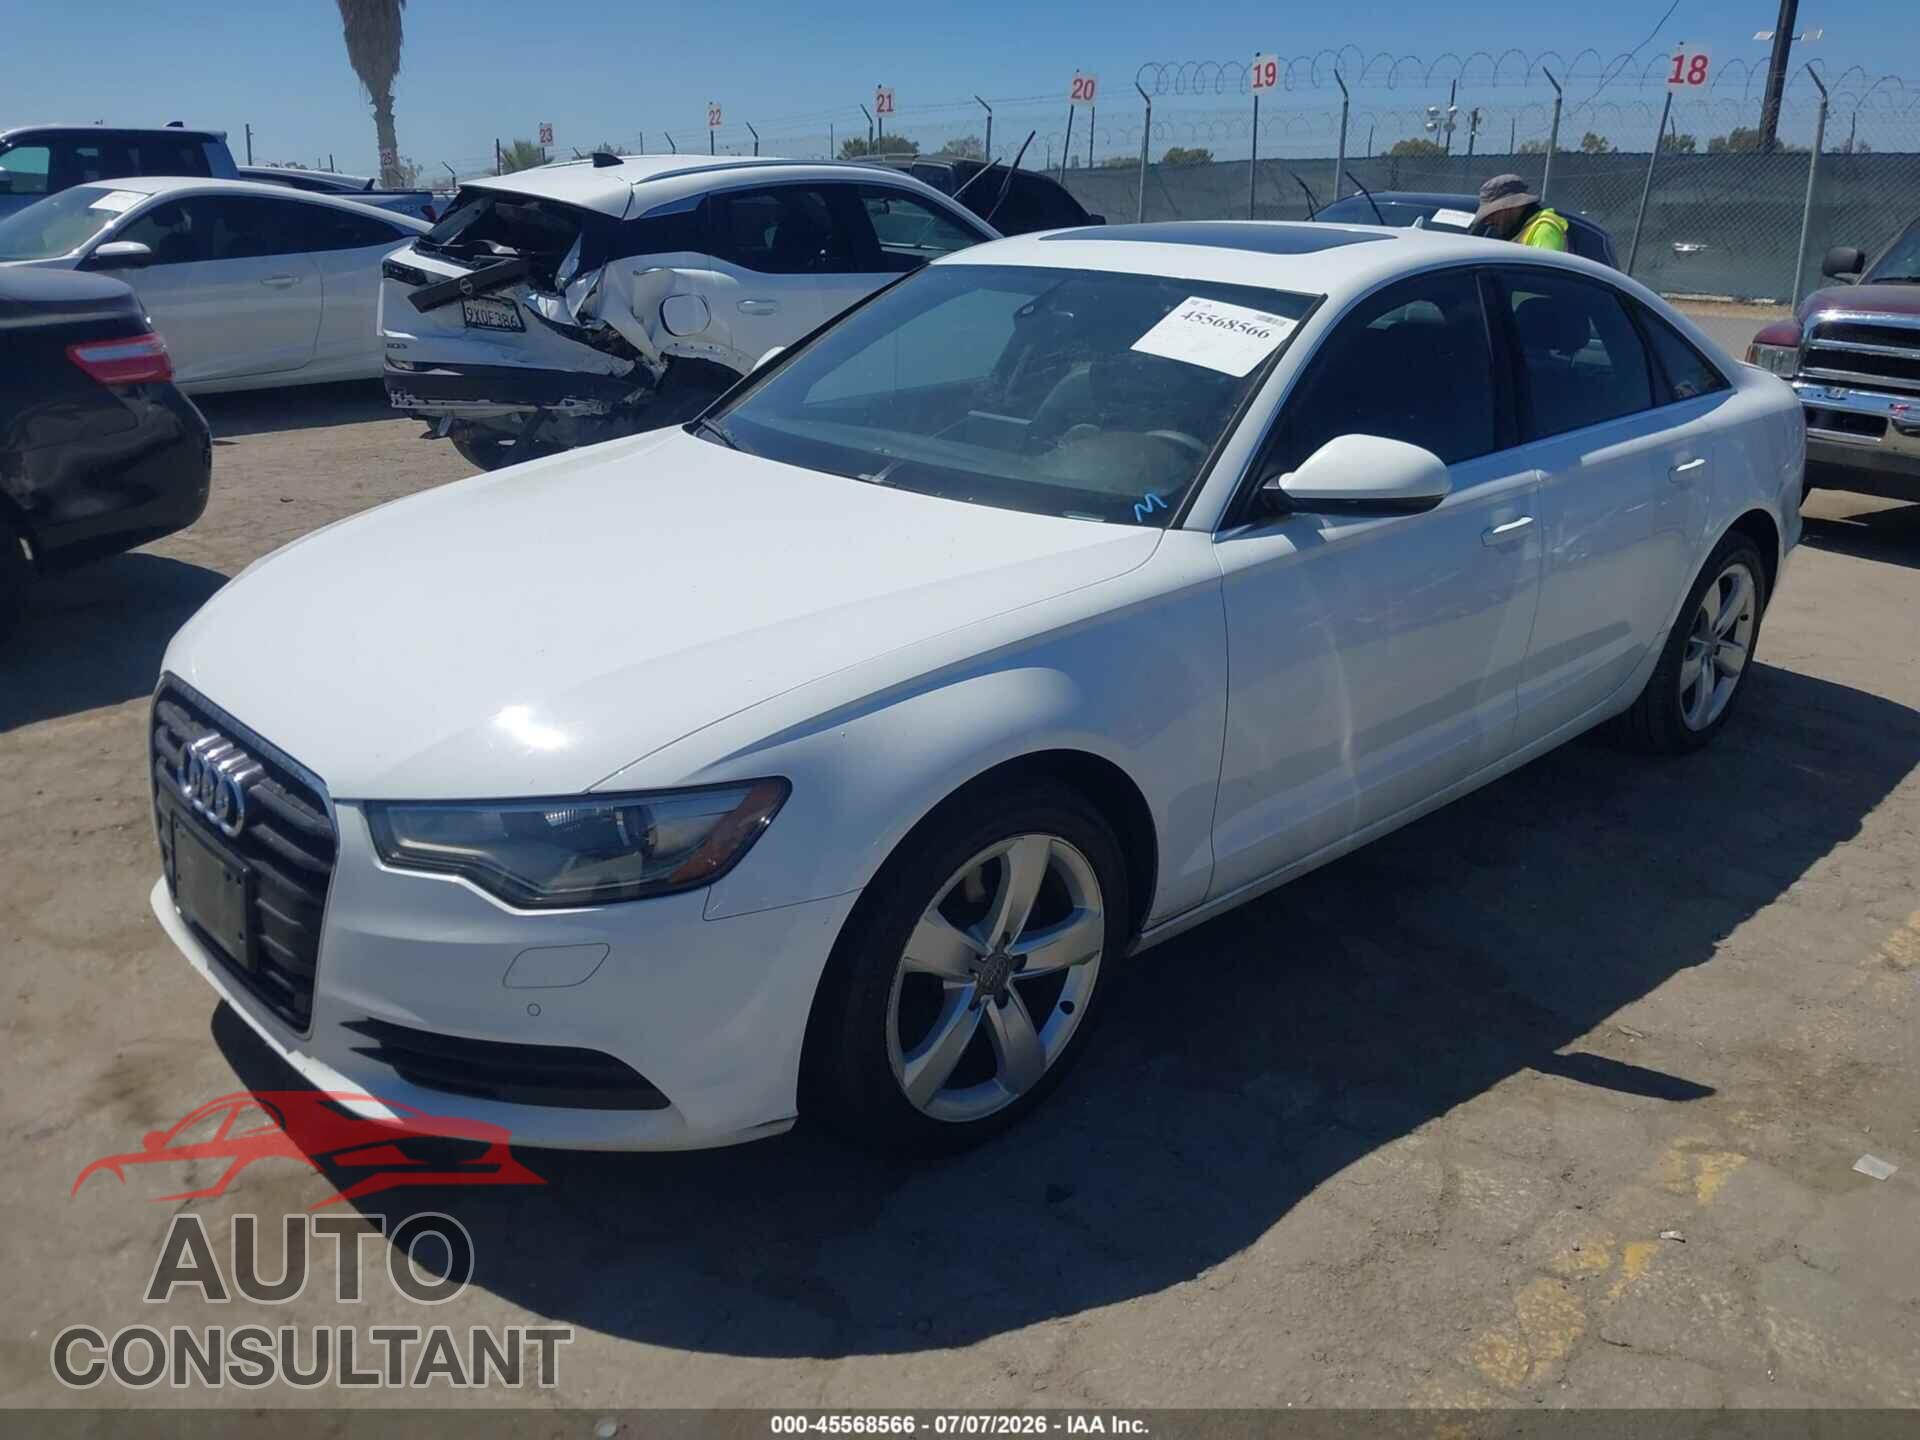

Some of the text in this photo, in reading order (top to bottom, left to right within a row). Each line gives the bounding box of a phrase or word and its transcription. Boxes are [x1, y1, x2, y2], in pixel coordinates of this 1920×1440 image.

[1253, 62, 1276, 88] 19
[1668, 54, 1708, 85] 18
[1072, 78, 1095, 101] 20
[876, 93, 894, 113] 21
[709, 109, 722, 126] 22
[1180, 310, 1271, 340] 45568566
